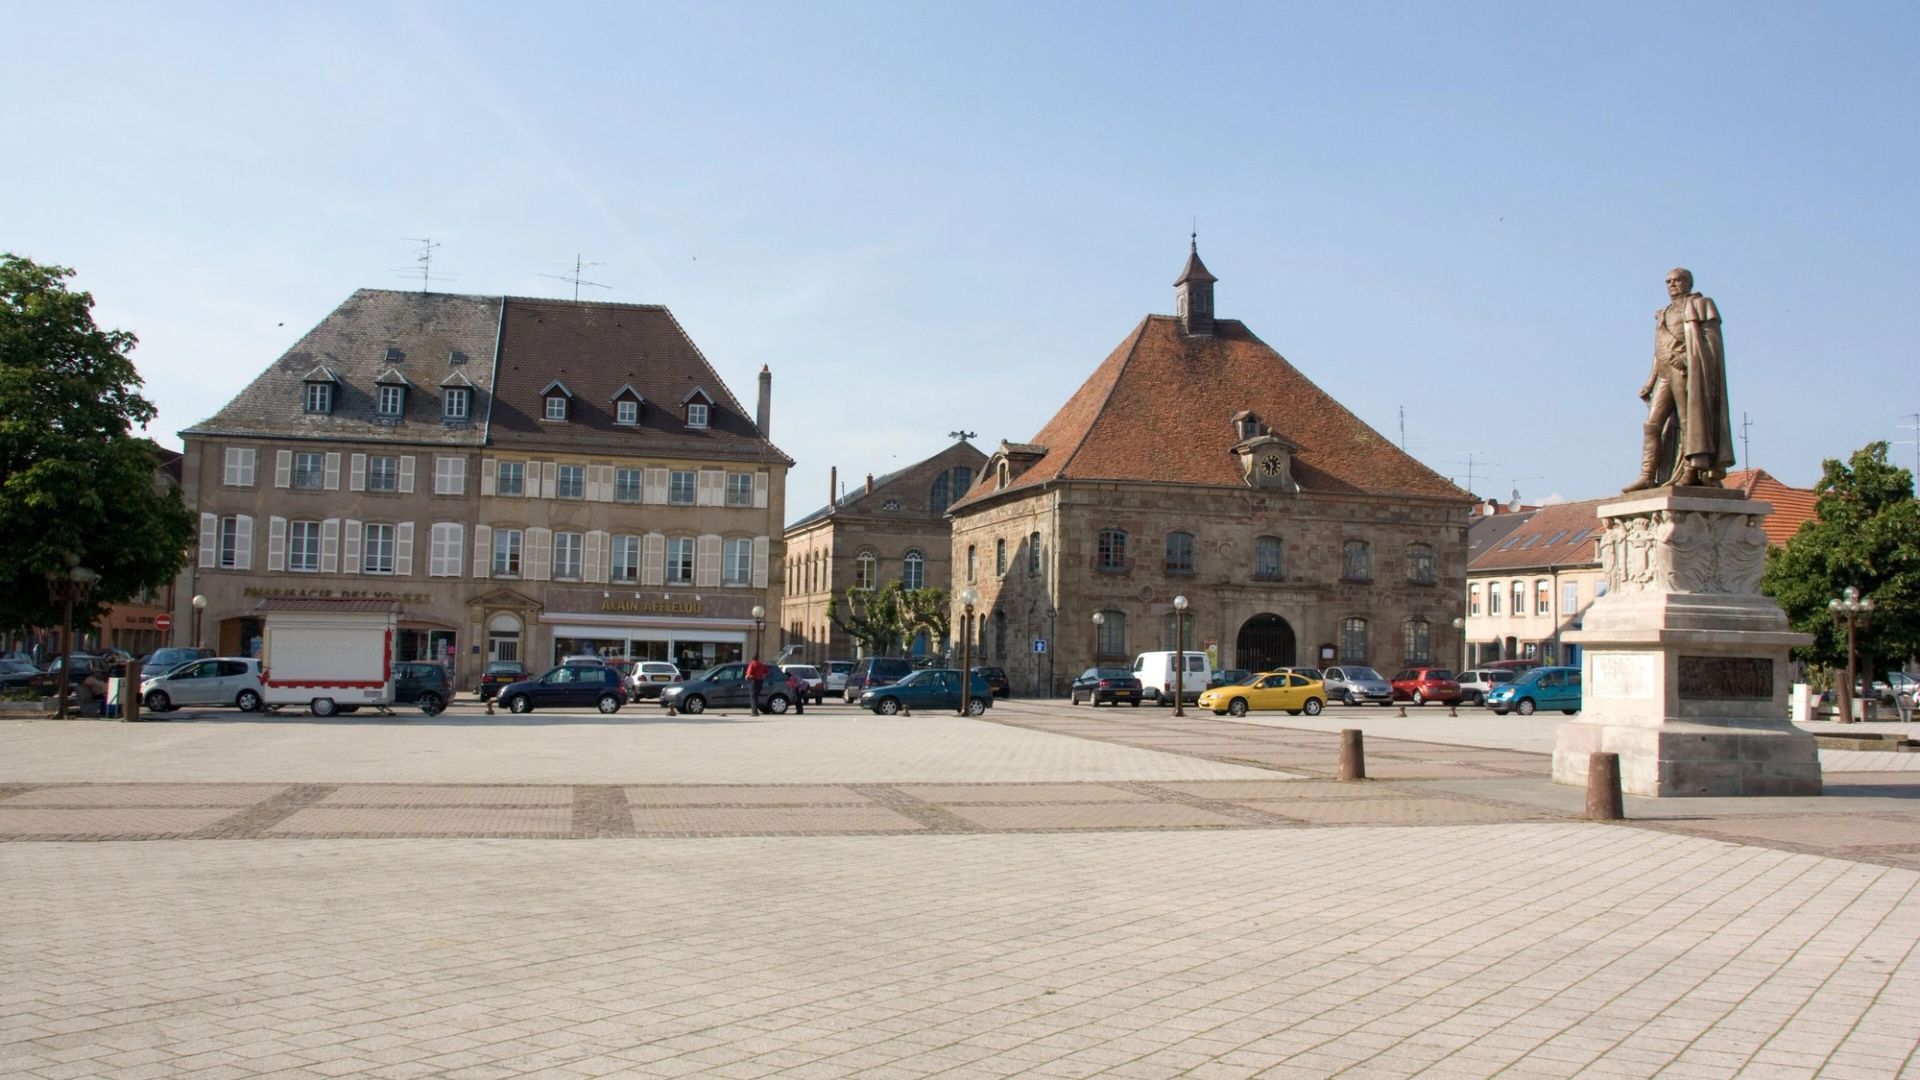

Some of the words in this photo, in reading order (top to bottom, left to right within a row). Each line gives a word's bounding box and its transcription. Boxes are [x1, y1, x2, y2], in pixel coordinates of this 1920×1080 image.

[341, 590, 368, 598] DES
[601, 599, 639, 611] ALAIN
[643, 601, 703, 614] AFFLELOU
